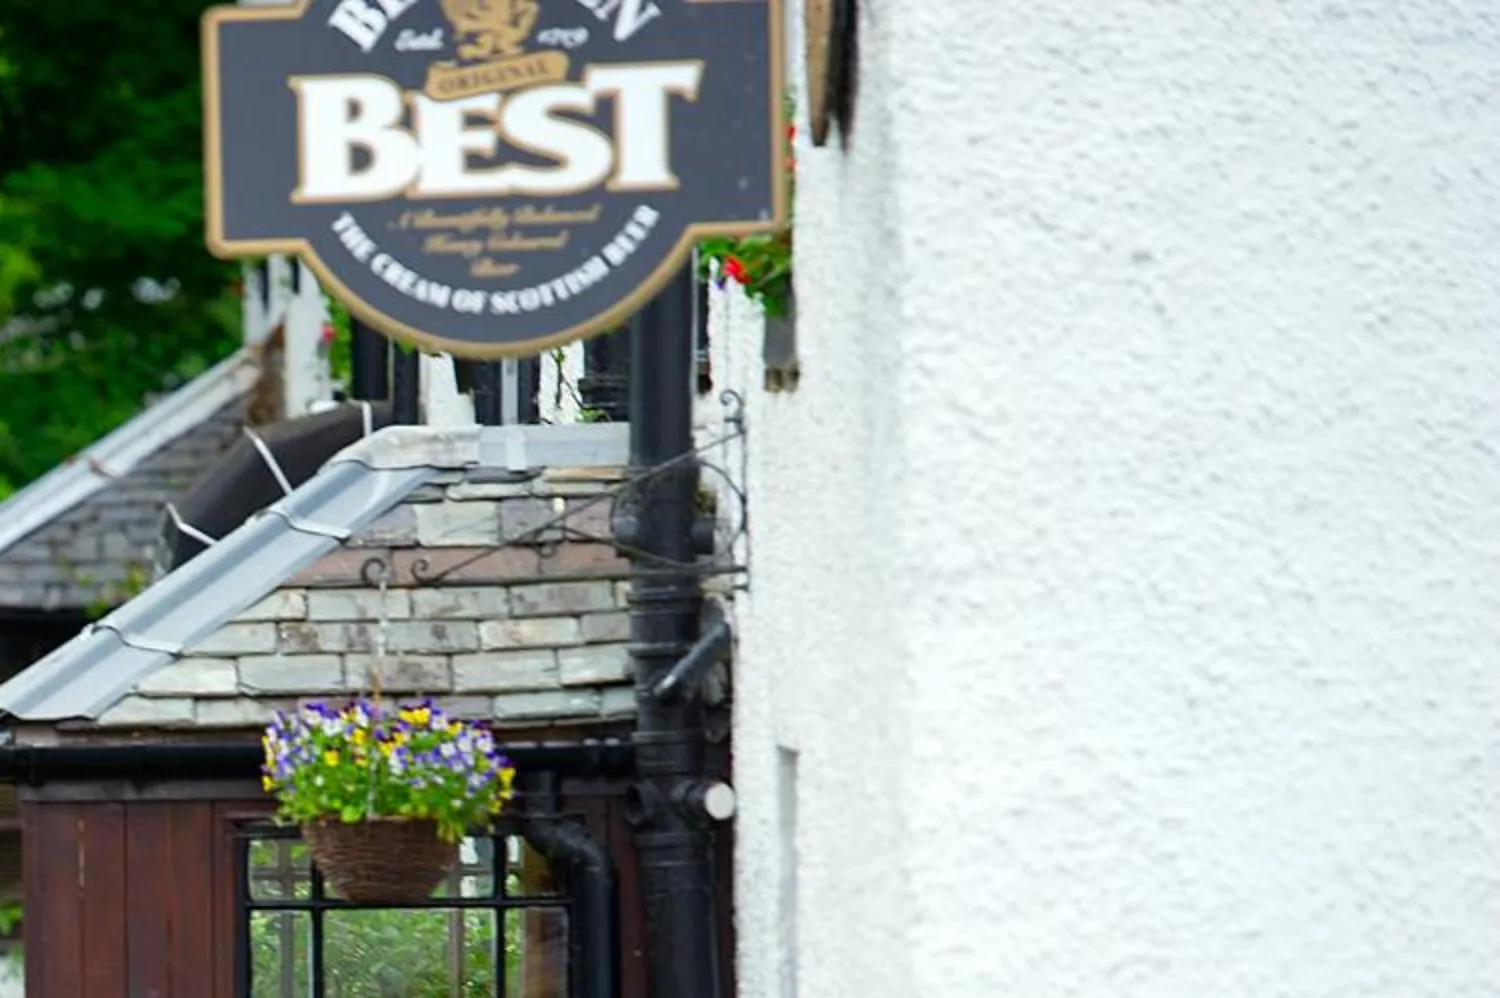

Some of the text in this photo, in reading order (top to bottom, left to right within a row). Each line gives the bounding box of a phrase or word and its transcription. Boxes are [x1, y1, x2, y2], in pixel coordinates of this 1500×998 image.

[288, 61, 704, 203] BEST
[331, 204, 661, 315] THE CREAM OF SCOTTISH BEER
